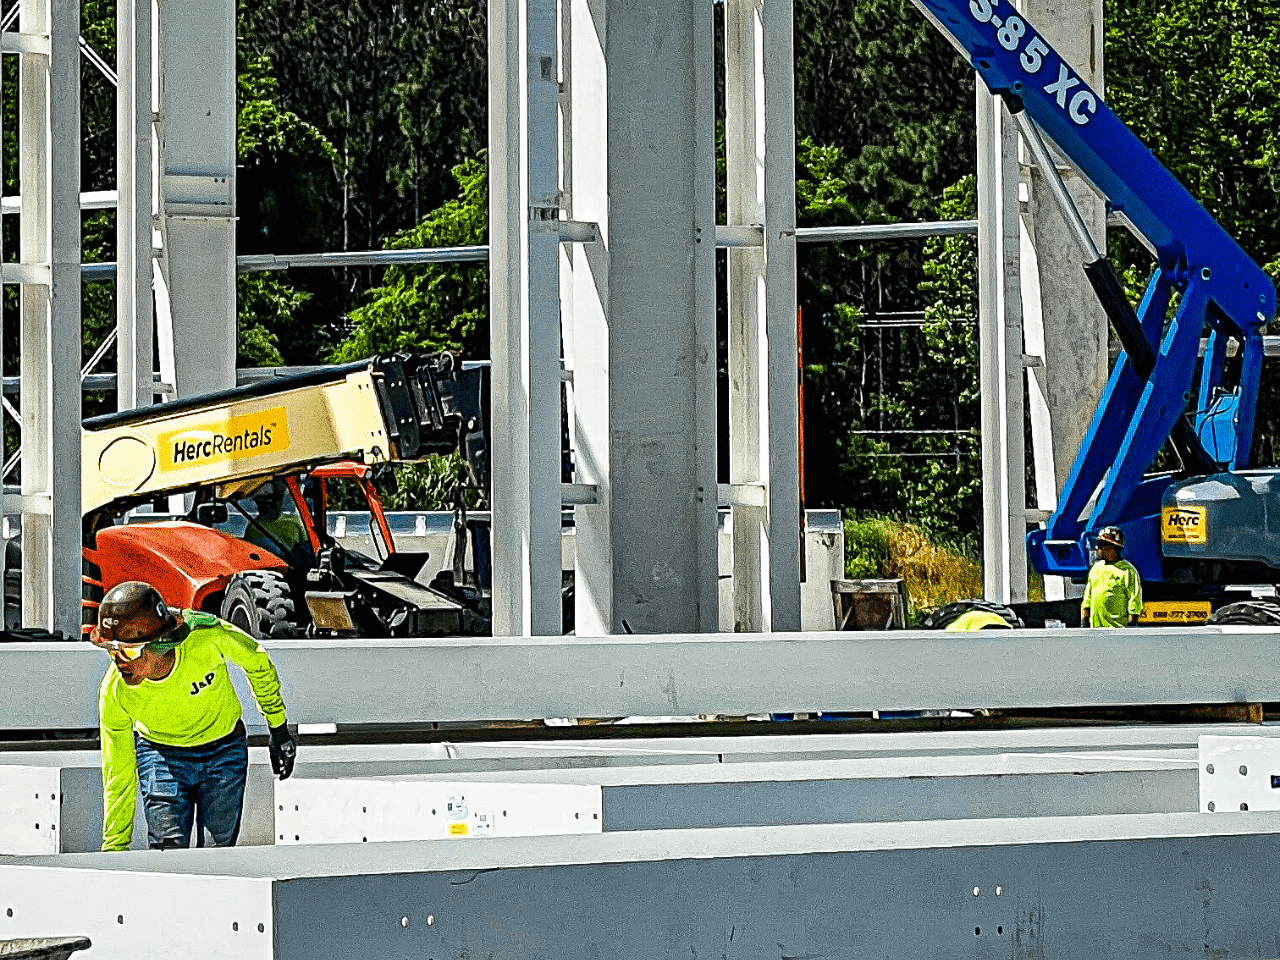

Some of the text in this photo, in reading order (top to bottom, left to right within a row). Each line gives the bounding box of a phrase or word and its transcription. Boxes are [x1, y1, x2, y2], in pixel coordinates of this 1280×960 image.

[1043, 62, 1097, 125] XC
[174, 424, 272, 464] HercRentals
[1168, 514, 1200, 526] Herc
[190, 672, 215, 695] J&P
